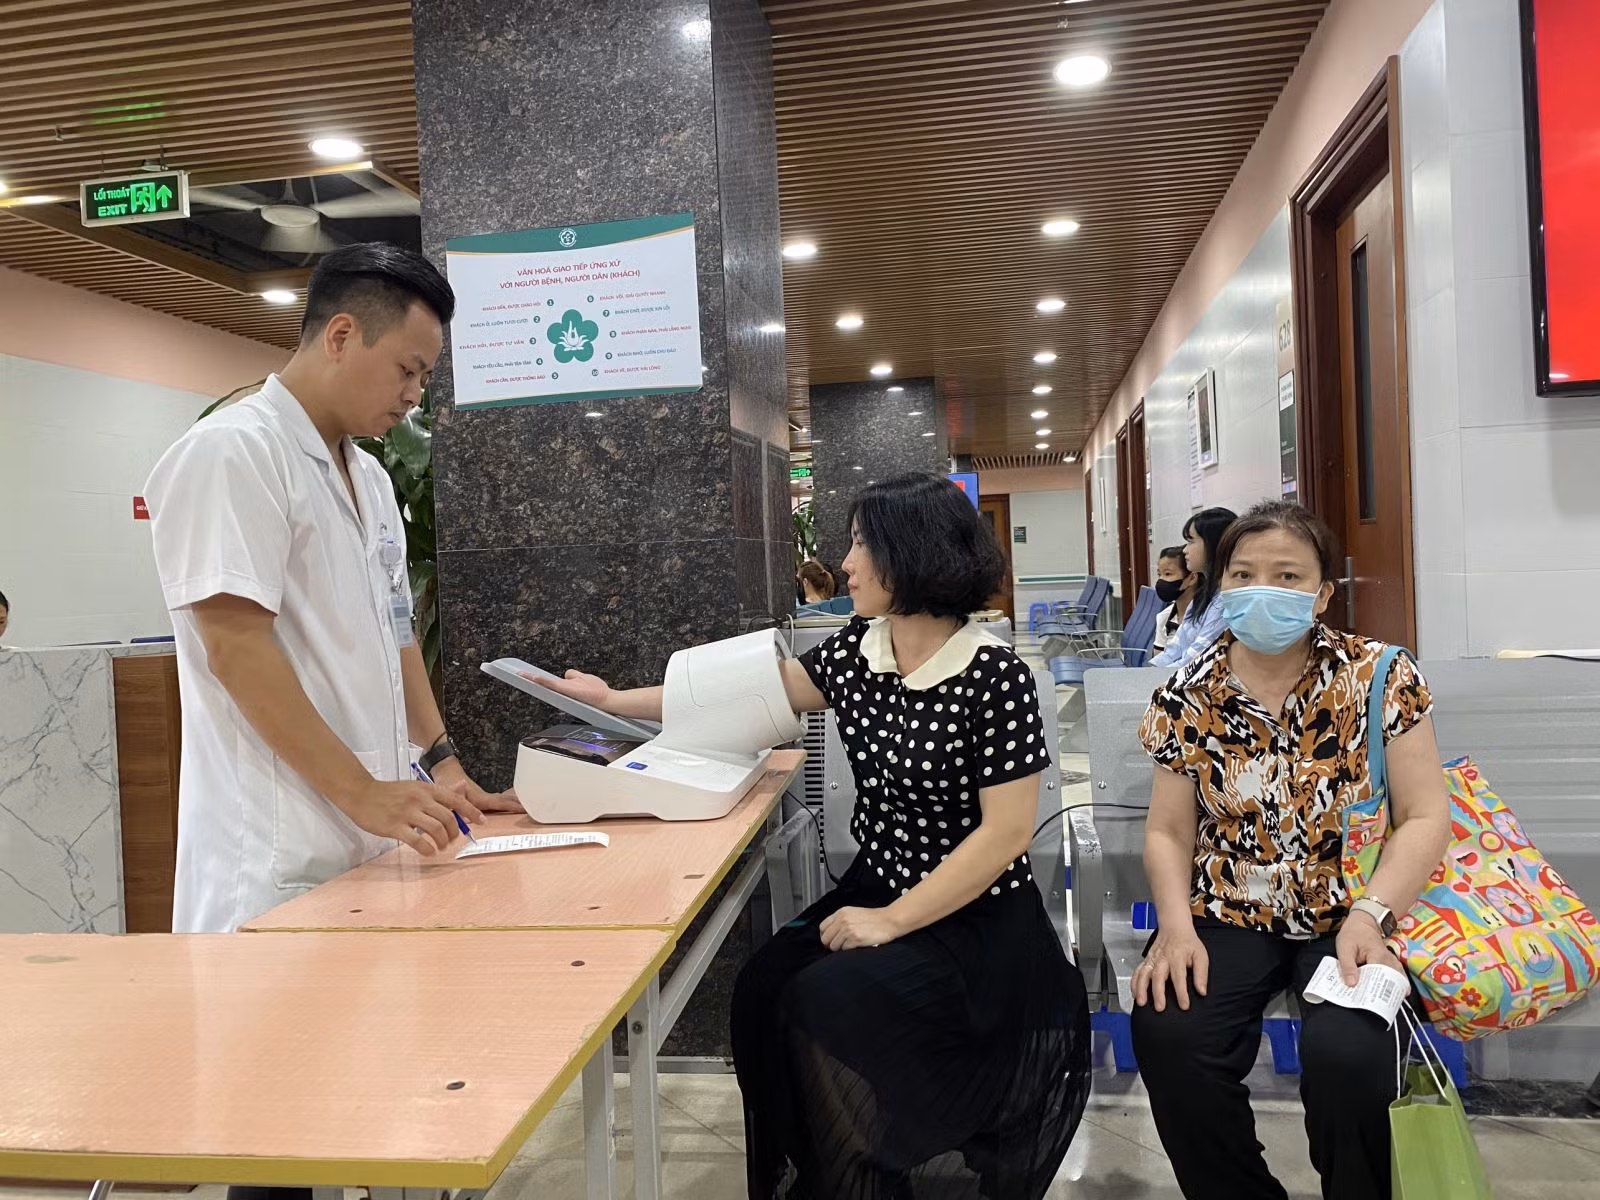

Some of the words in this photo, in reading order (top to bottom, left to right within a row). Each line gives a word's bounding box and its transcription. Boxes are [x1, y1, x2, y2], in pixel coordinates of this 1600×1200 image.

[94, 188, 106, 200] LỐI
[107, 186, 130, 199] THOÁT
[98, 204, 128, 216] EXIT
[517, 268, 533, 276] VĂN
[553, 265, 571, 273] GIAO
[573, 262, 588, 270] TIẾP
[590, 260, 608, 269] ỨNG
[500, 281, 512, 289] VỚI
[514, 278, 539, 288] NGƯỜI
[542, 277, 562, 286] BỆNH,
[565, 274, 590, 283] NGƯỜI
[592, 272, 608, 280] DÂN
[610, 269, 640, 280] (KHÁCH)
[1279, 319, 1292, 352] 628
